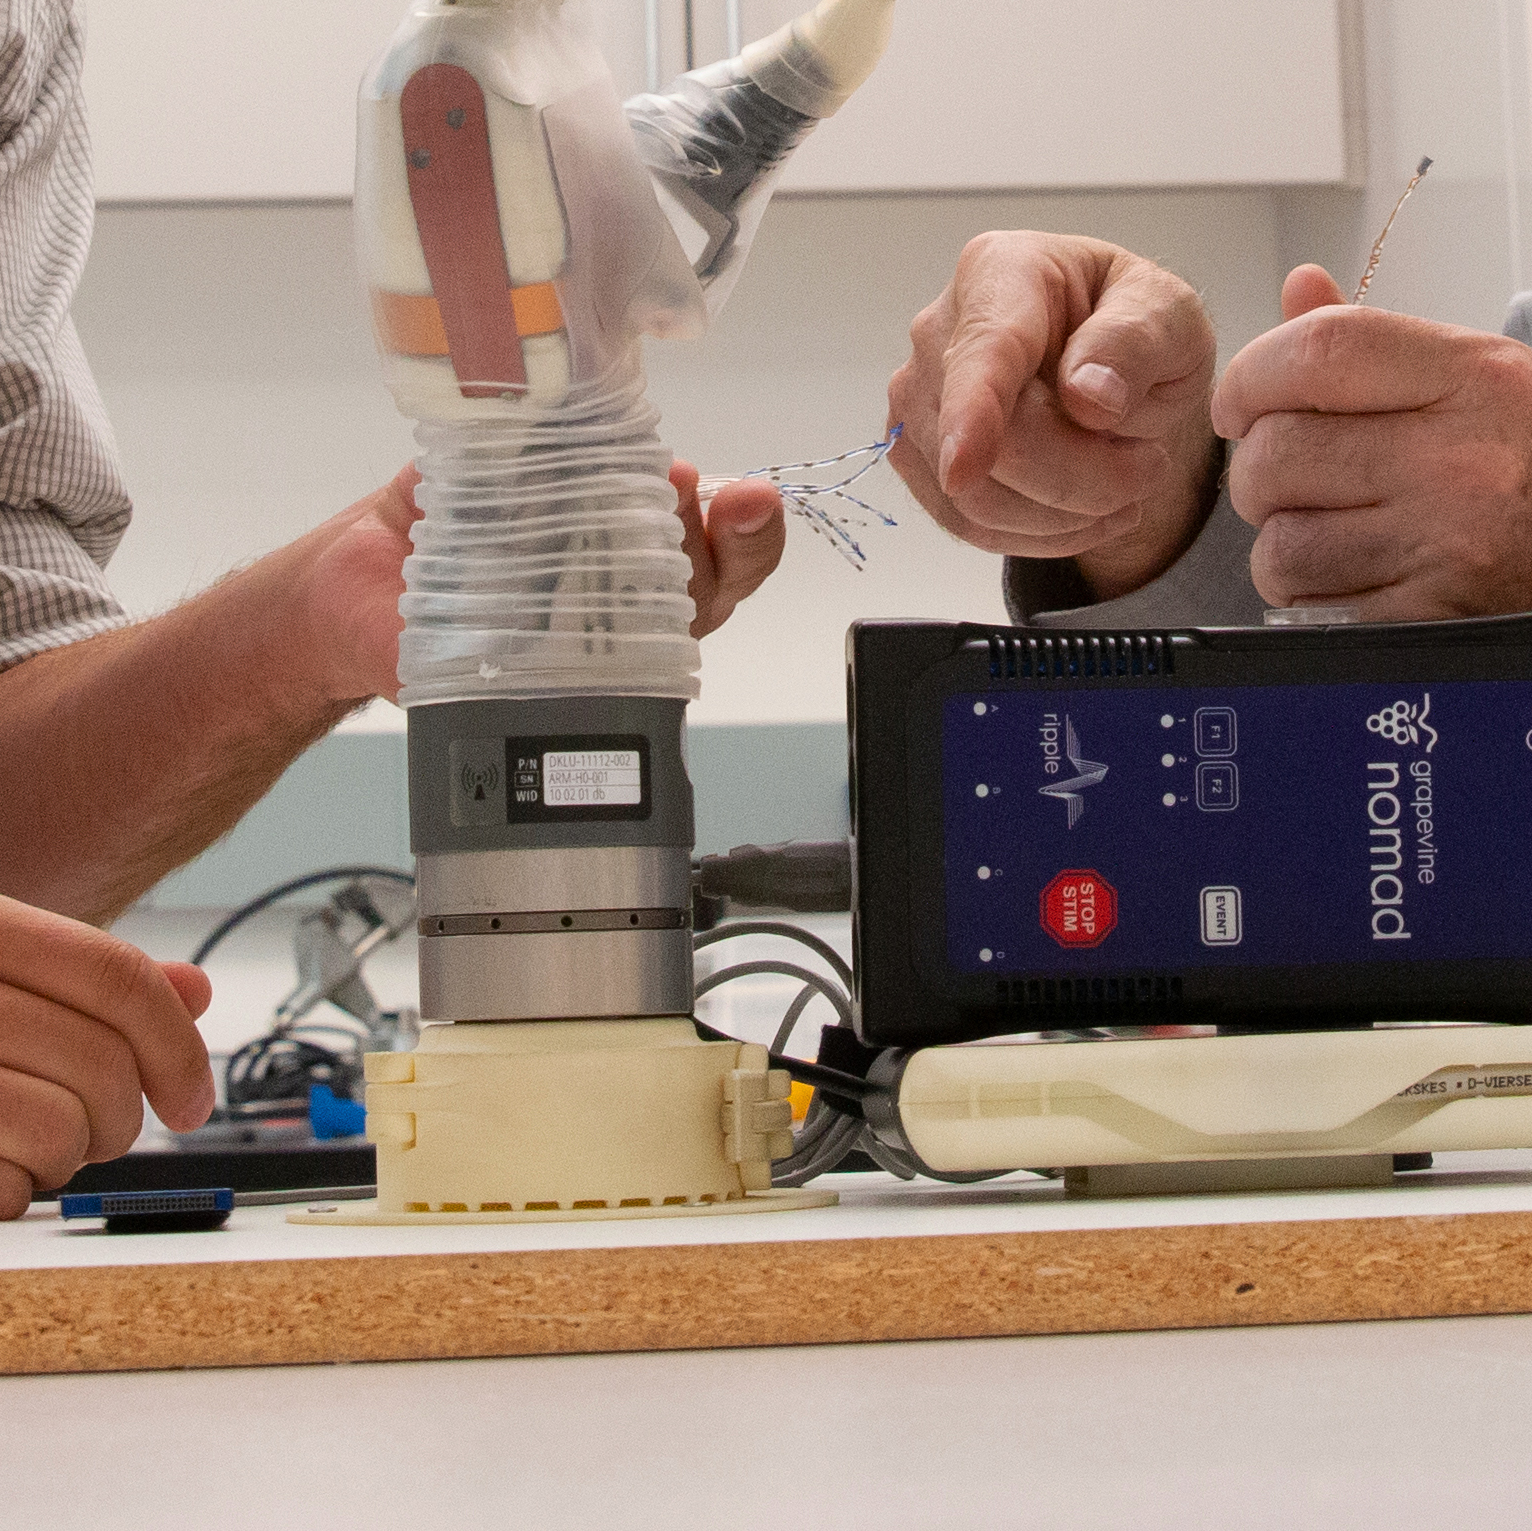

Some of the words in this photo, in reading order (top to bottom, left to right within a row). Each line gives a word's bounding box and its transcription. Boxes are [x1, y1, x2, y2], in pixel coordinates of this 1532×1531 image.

[1039, 713, 1061, 774] ripple
[1210, 725, 1221, 739] F1
[517, 757, 538, 770] P/N
[515, 790, 539, 802] WID
[1211, 779, 1223, 794] F2
[1409, 760, 1438, 884] grapevine
[1367, 762, 1412, 940] nomad
[1062, 885, 1078, 932] STIM
[1080, 882, 1095, 935] STOP
[1215, 894, 1227, 936] EVENT
[1396, 1080, 1448, 1097] KSKES
